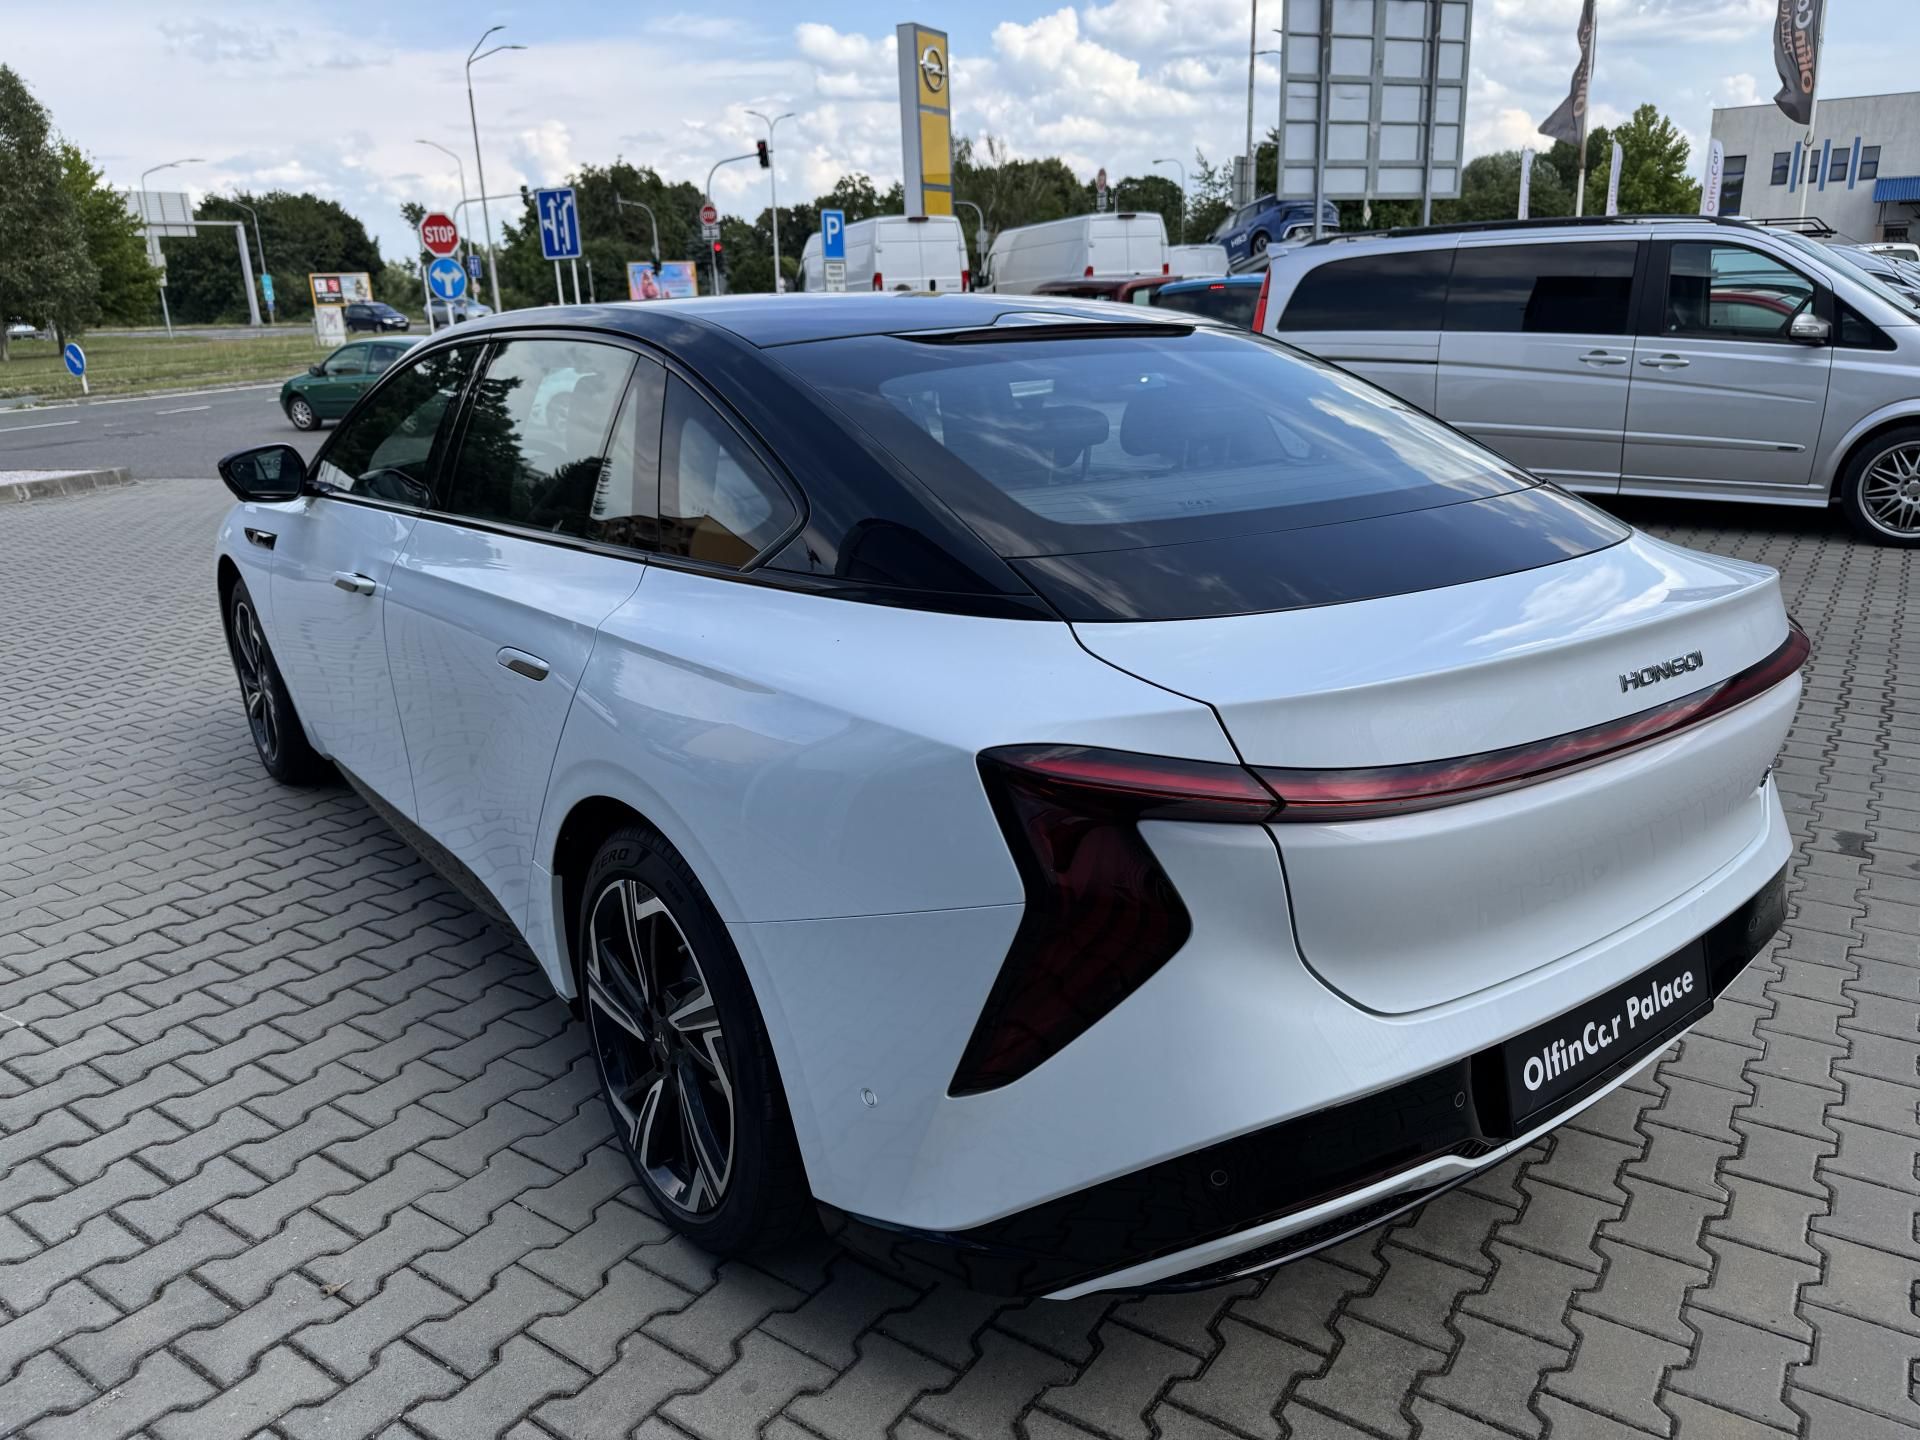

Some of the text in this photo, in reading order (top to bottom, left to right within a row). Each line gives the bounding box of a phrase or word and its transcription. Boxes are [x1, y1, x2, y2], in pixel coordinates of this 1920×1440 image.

[424, 225, 455, 243] STOP
[826, 216, 840, 245] P
[1619, 650, 1703, 693] HONGQI
[1523, 970, 1693, 1091] OlfinCar Palace
